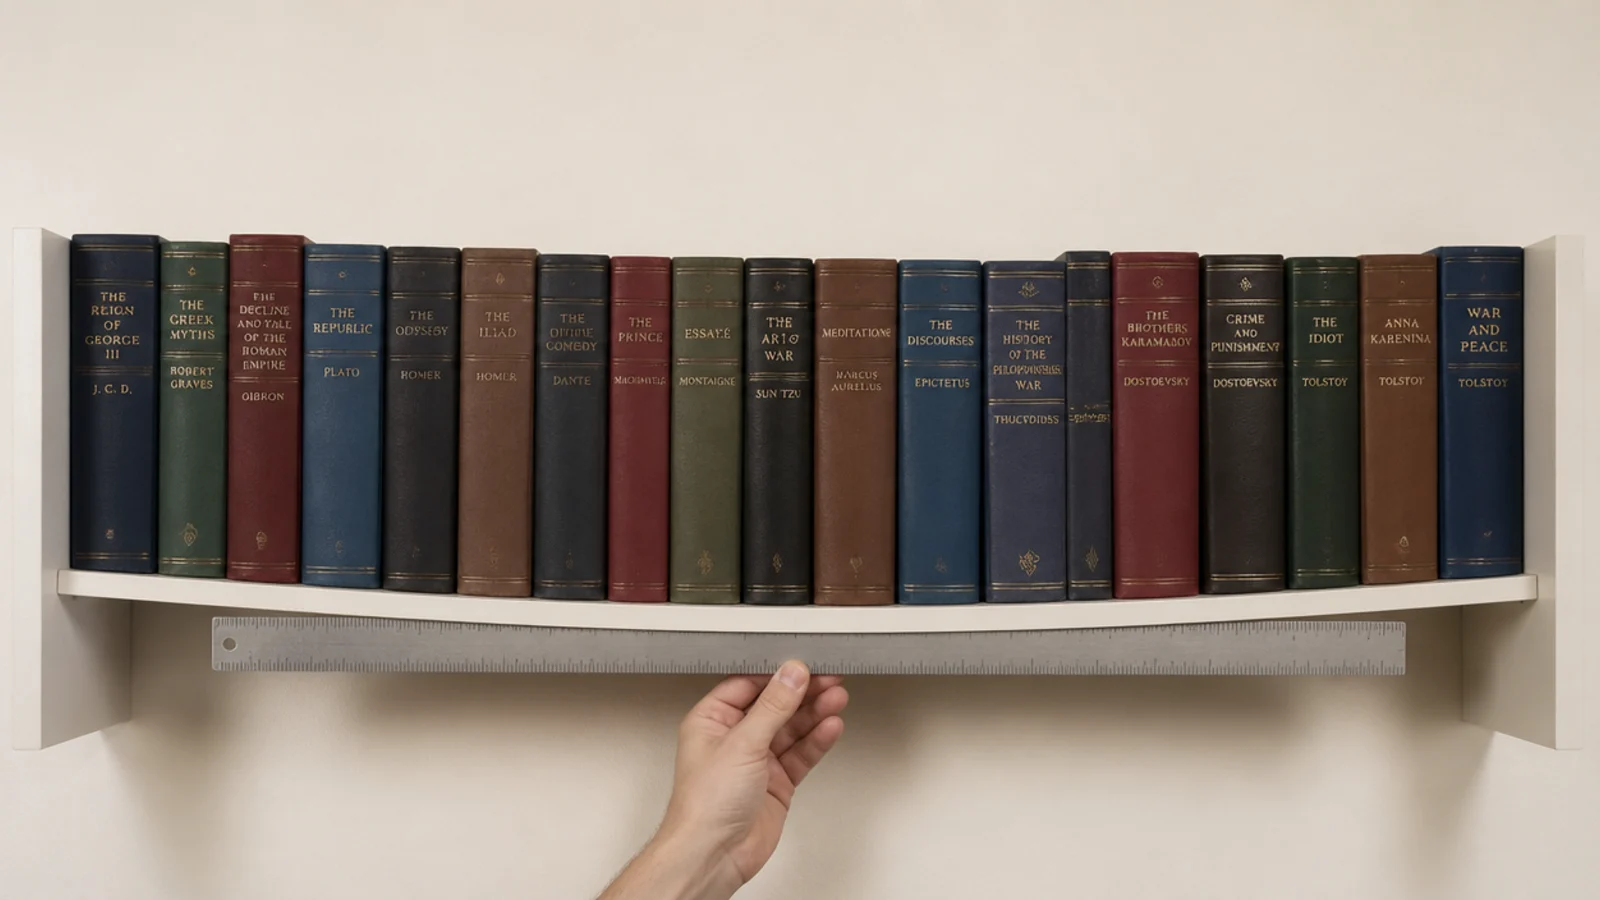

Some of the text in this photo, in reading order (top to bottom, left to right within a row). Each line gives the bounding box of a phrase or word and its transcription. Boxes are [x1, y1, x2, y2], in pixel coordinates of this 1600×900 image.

[100, 291, 127, 302] THE
[179, 299, 205, 311] THE
[330, 307, 356, 318] THE
[409, 310, 435, 321] THE
[484, 311, 511, 323] THE
[1145, 310, 1170, 320] THE
[1466, 307, 1502, 319] WAR
[559, 313, 585, 324] THE
[628, 317, 652, 328] THE
[766, 316, 793, 328] THE
[1225, 314, 1265, 325] CRIME
[1312, 316, 1338, 328] THE
[1384, 318, 1420, 329] ANNA
[103, 320, 121, 331] OF
[928, 319, 953, 330] THE
[1015, 320, 1041, 331] THE
[1468, 324, 1500, 336] AND
[85, 334, 140, 346] GEORGE
[617, 332, 663, 343] PRINCE
[907, 336, 975, 346] DISCOURSES
[1308, 333, 1345, 344] IDIOT
[1370, 333, 1432, 344] KARENINA
[1460, 340, 1509, 353] PEACE
[105, 349, 120, 359] III
[764, 350, 795, 362] WAR
[1023, 349, 1047, 360] THE
[323, 367, 360, 378] PLATO
[476, 372, 517, 382] HOMER
[553, 376, 592, 386] DANTE
[915, 377, 971, 389] EPICTETUS
[1015, 380, 1042, 391] WAR
[1123, 376, 1191, 387] DOSTOEVSKY
[1213, 378, 1278, 388] DOSTOEVSKY
[1302, 377, 1349, 387] TOLSTOY
[1378, 376, 1426, 386] TOLSTOY
[1458, 378, 1509, 388] TOLSTOY
[755, 389, 801, 399] SUN TZU
